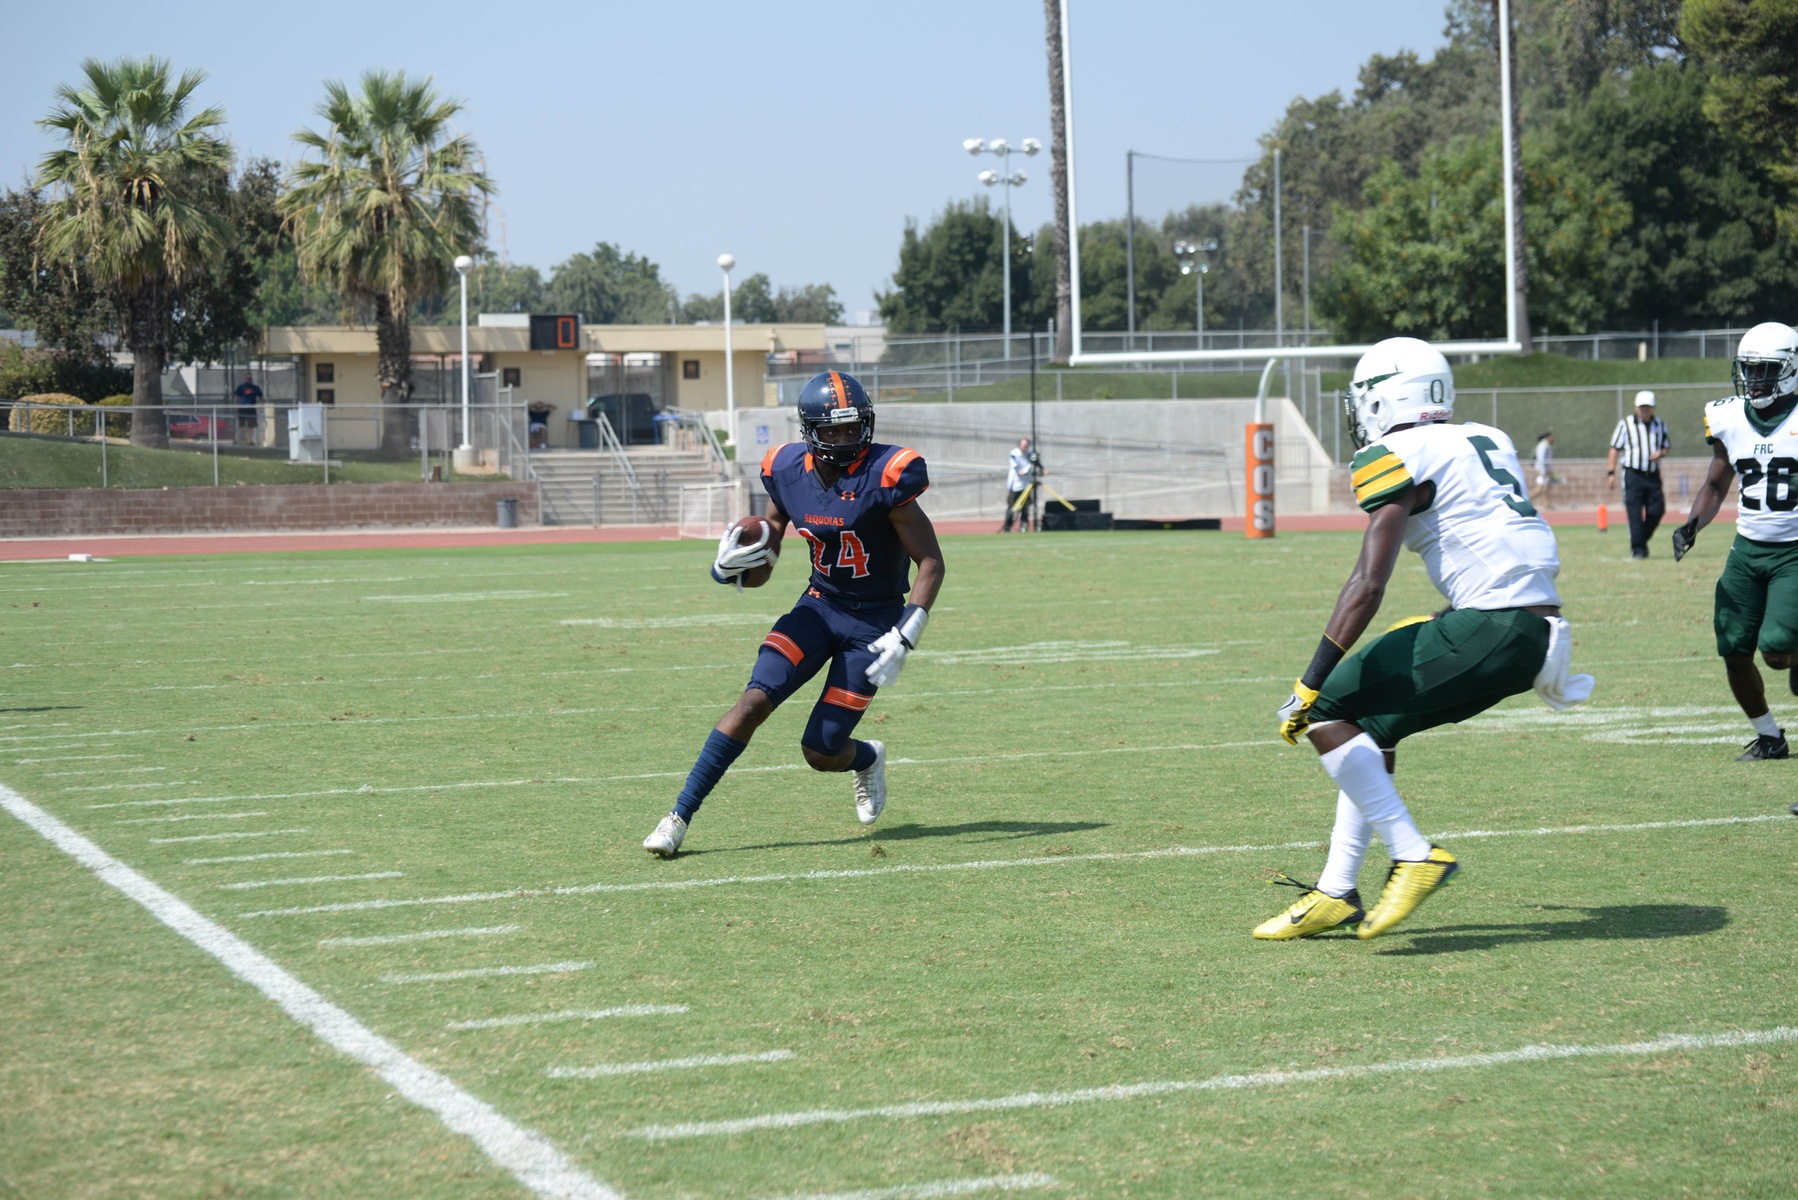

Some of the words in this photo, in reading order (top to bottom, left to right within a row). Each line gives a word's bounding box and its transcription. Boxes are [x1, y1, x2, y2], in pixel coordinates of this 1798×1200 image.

[557, 317, 575, 347] 0
[1753, 443, 1774, 454] FRC
[1253, 429, 1274, 530] COS
[1467, 435, 1537, 517] 5
[804, 513, 845, 527] SEQUOIAS
